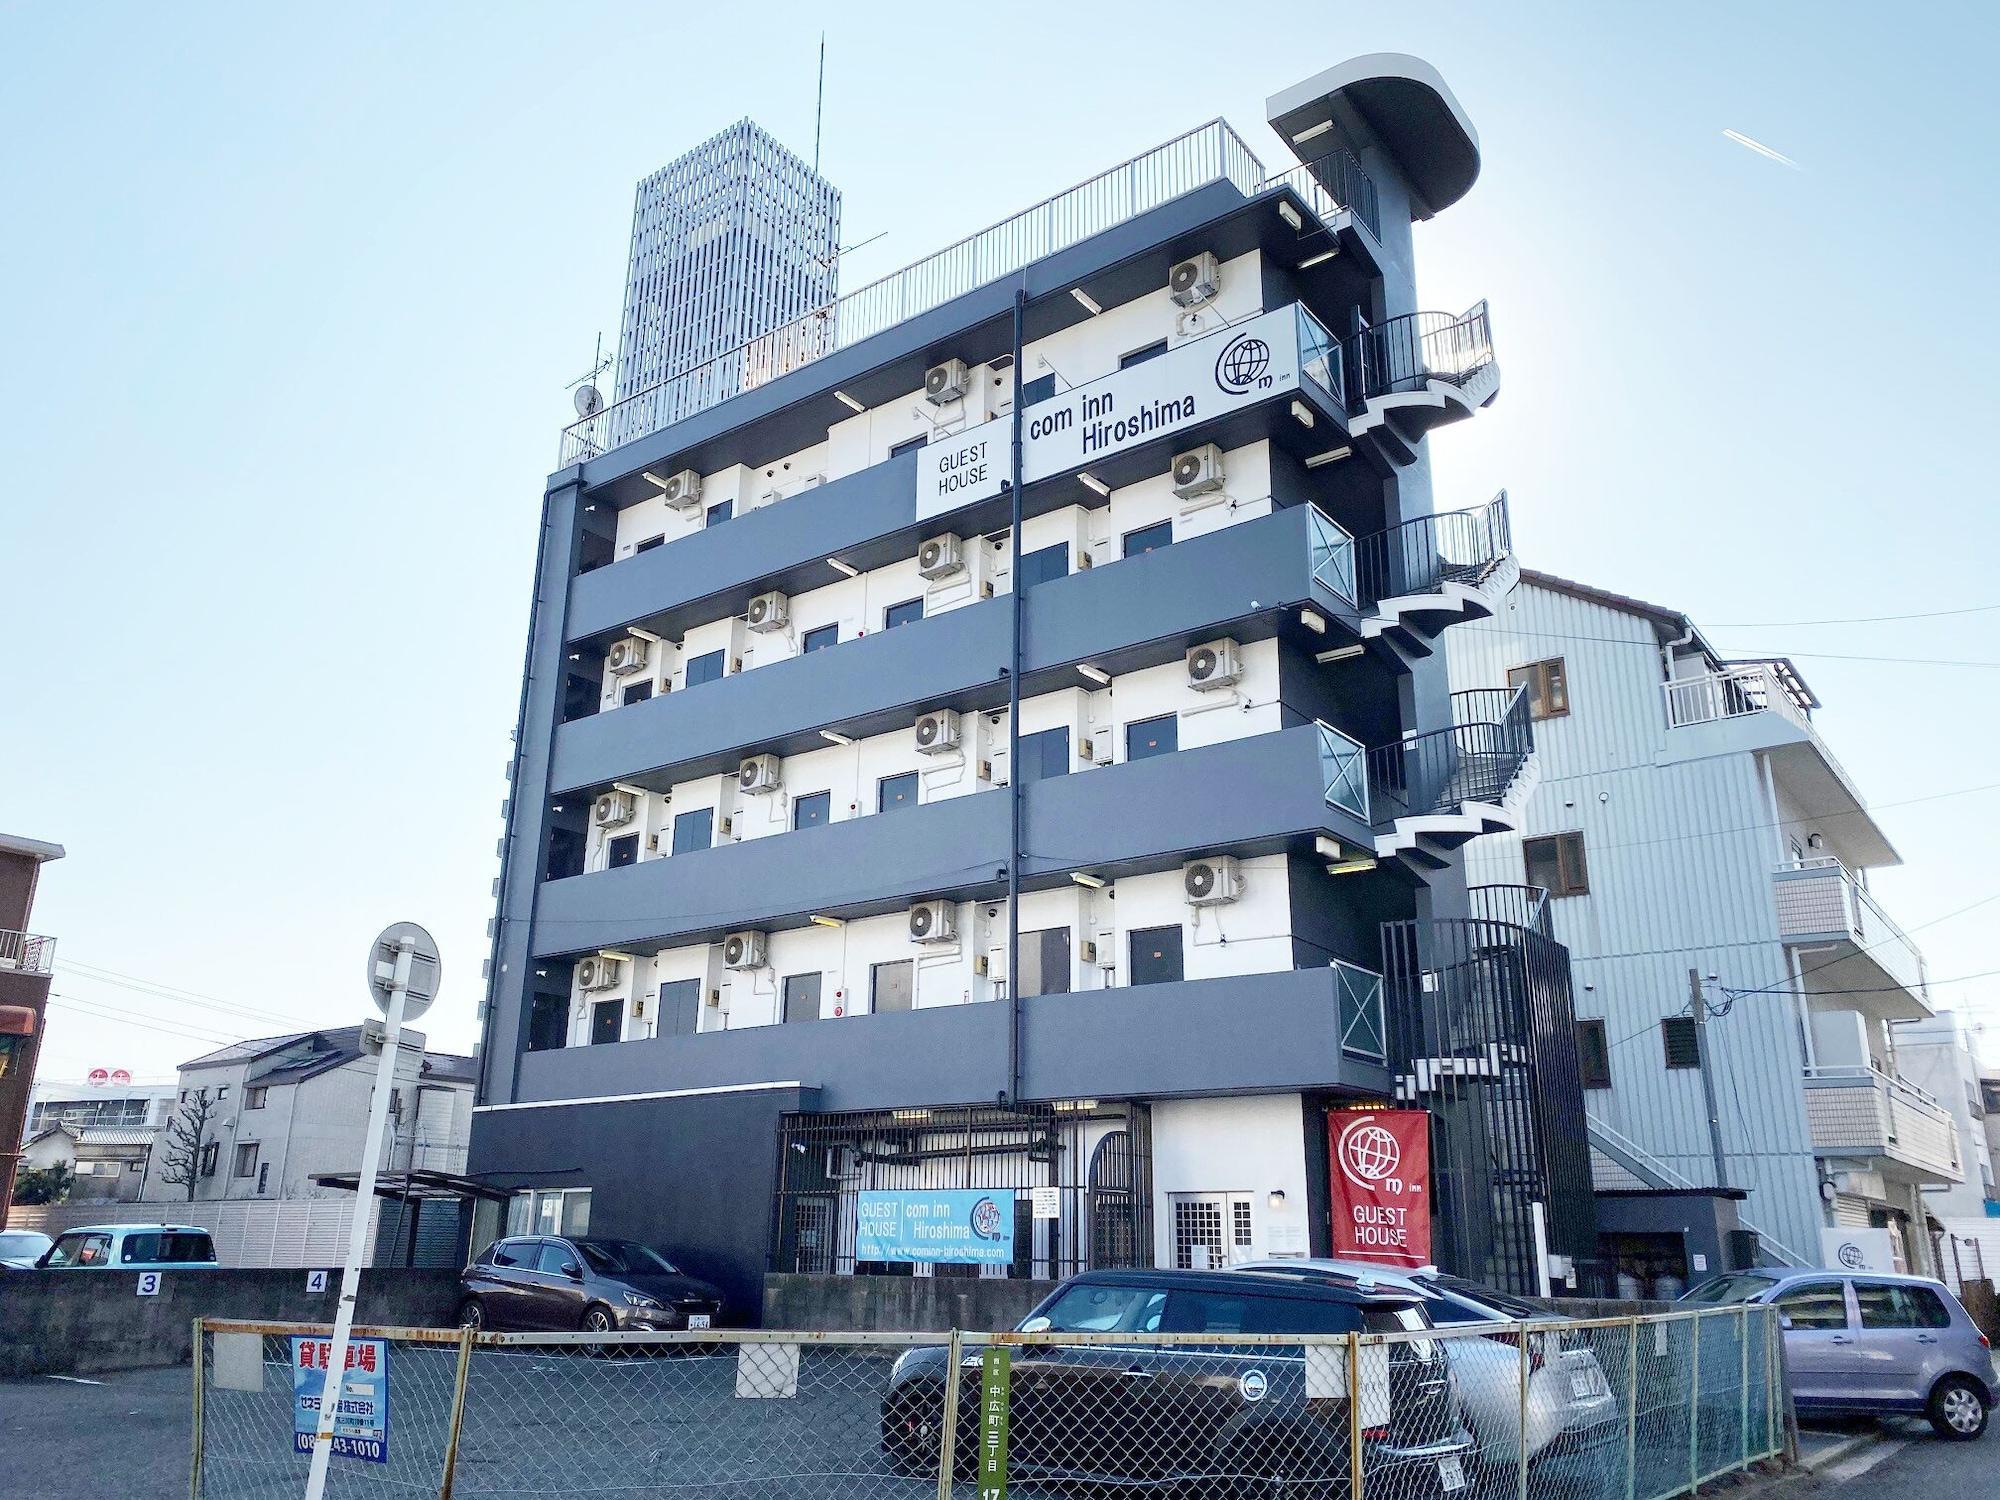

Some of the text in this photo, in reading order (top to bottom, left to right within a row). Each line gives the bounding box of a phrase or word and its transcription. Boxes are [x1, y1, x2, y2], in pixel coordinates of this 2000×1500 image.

[1030, 390, 1113, 441] com inn
[1081, 393, 1196, 455] Hiroshima
[939, 441, 988, 473] GUEST
[938, 463, 988, 497] HOUSE
[862, 1202, 898, 1218] GUEST
[906, 1200, 950, 1218] com inn
[1353, 1204, 1408, 1226] GUEST
[859, 1222, 897, 1238] HOUSE
[913, 1221, 971, 1240] Hiroshima
[1354, 1226, 1408, 1248] HOUSE
[141, 1274, 157, 1293] 3
[310, 1273, 322, 1290] 4
[987, 1384, 1001, 1472] 中広町三丁目
[982, 1488, 1000, 1500] 17
